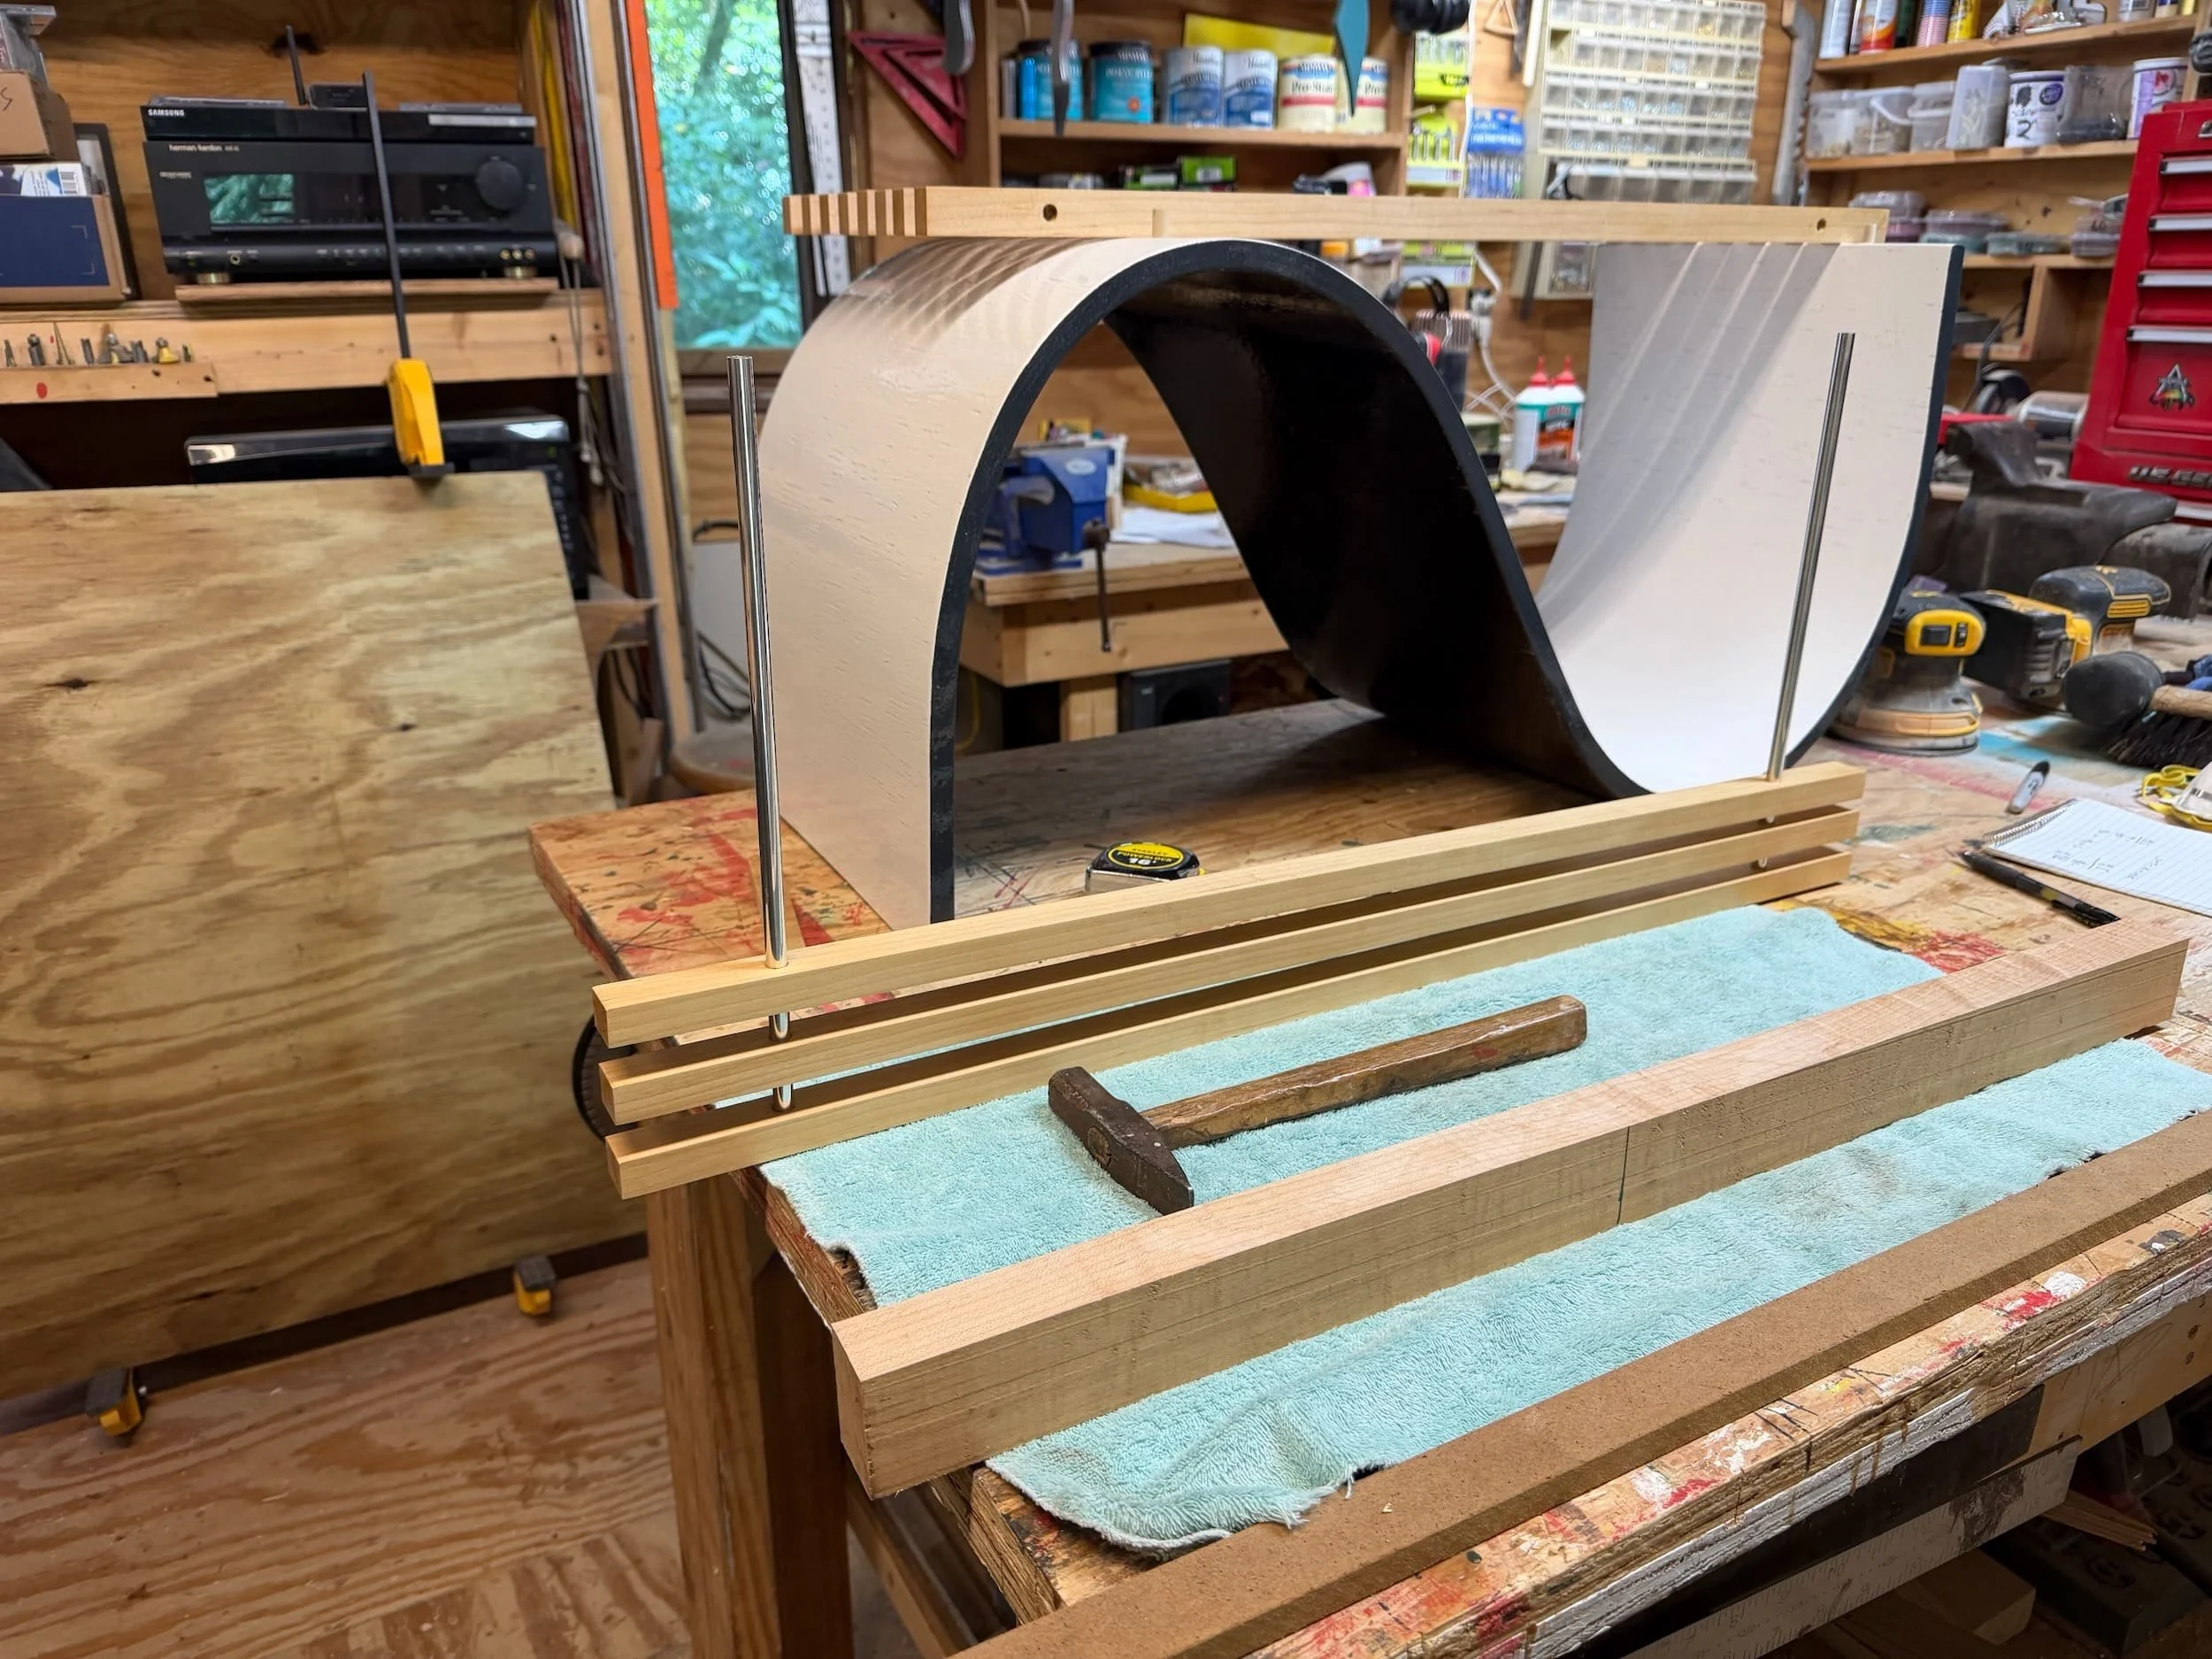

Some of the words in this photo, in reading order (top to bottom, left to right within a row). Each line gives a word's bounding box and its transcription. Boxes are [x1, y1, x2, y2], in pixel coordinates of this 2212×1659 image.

[147, 108, 186, 118] SAMSUNG
[168, 143, 196, 152] harman
[197, 143, 222, 152] kardon
